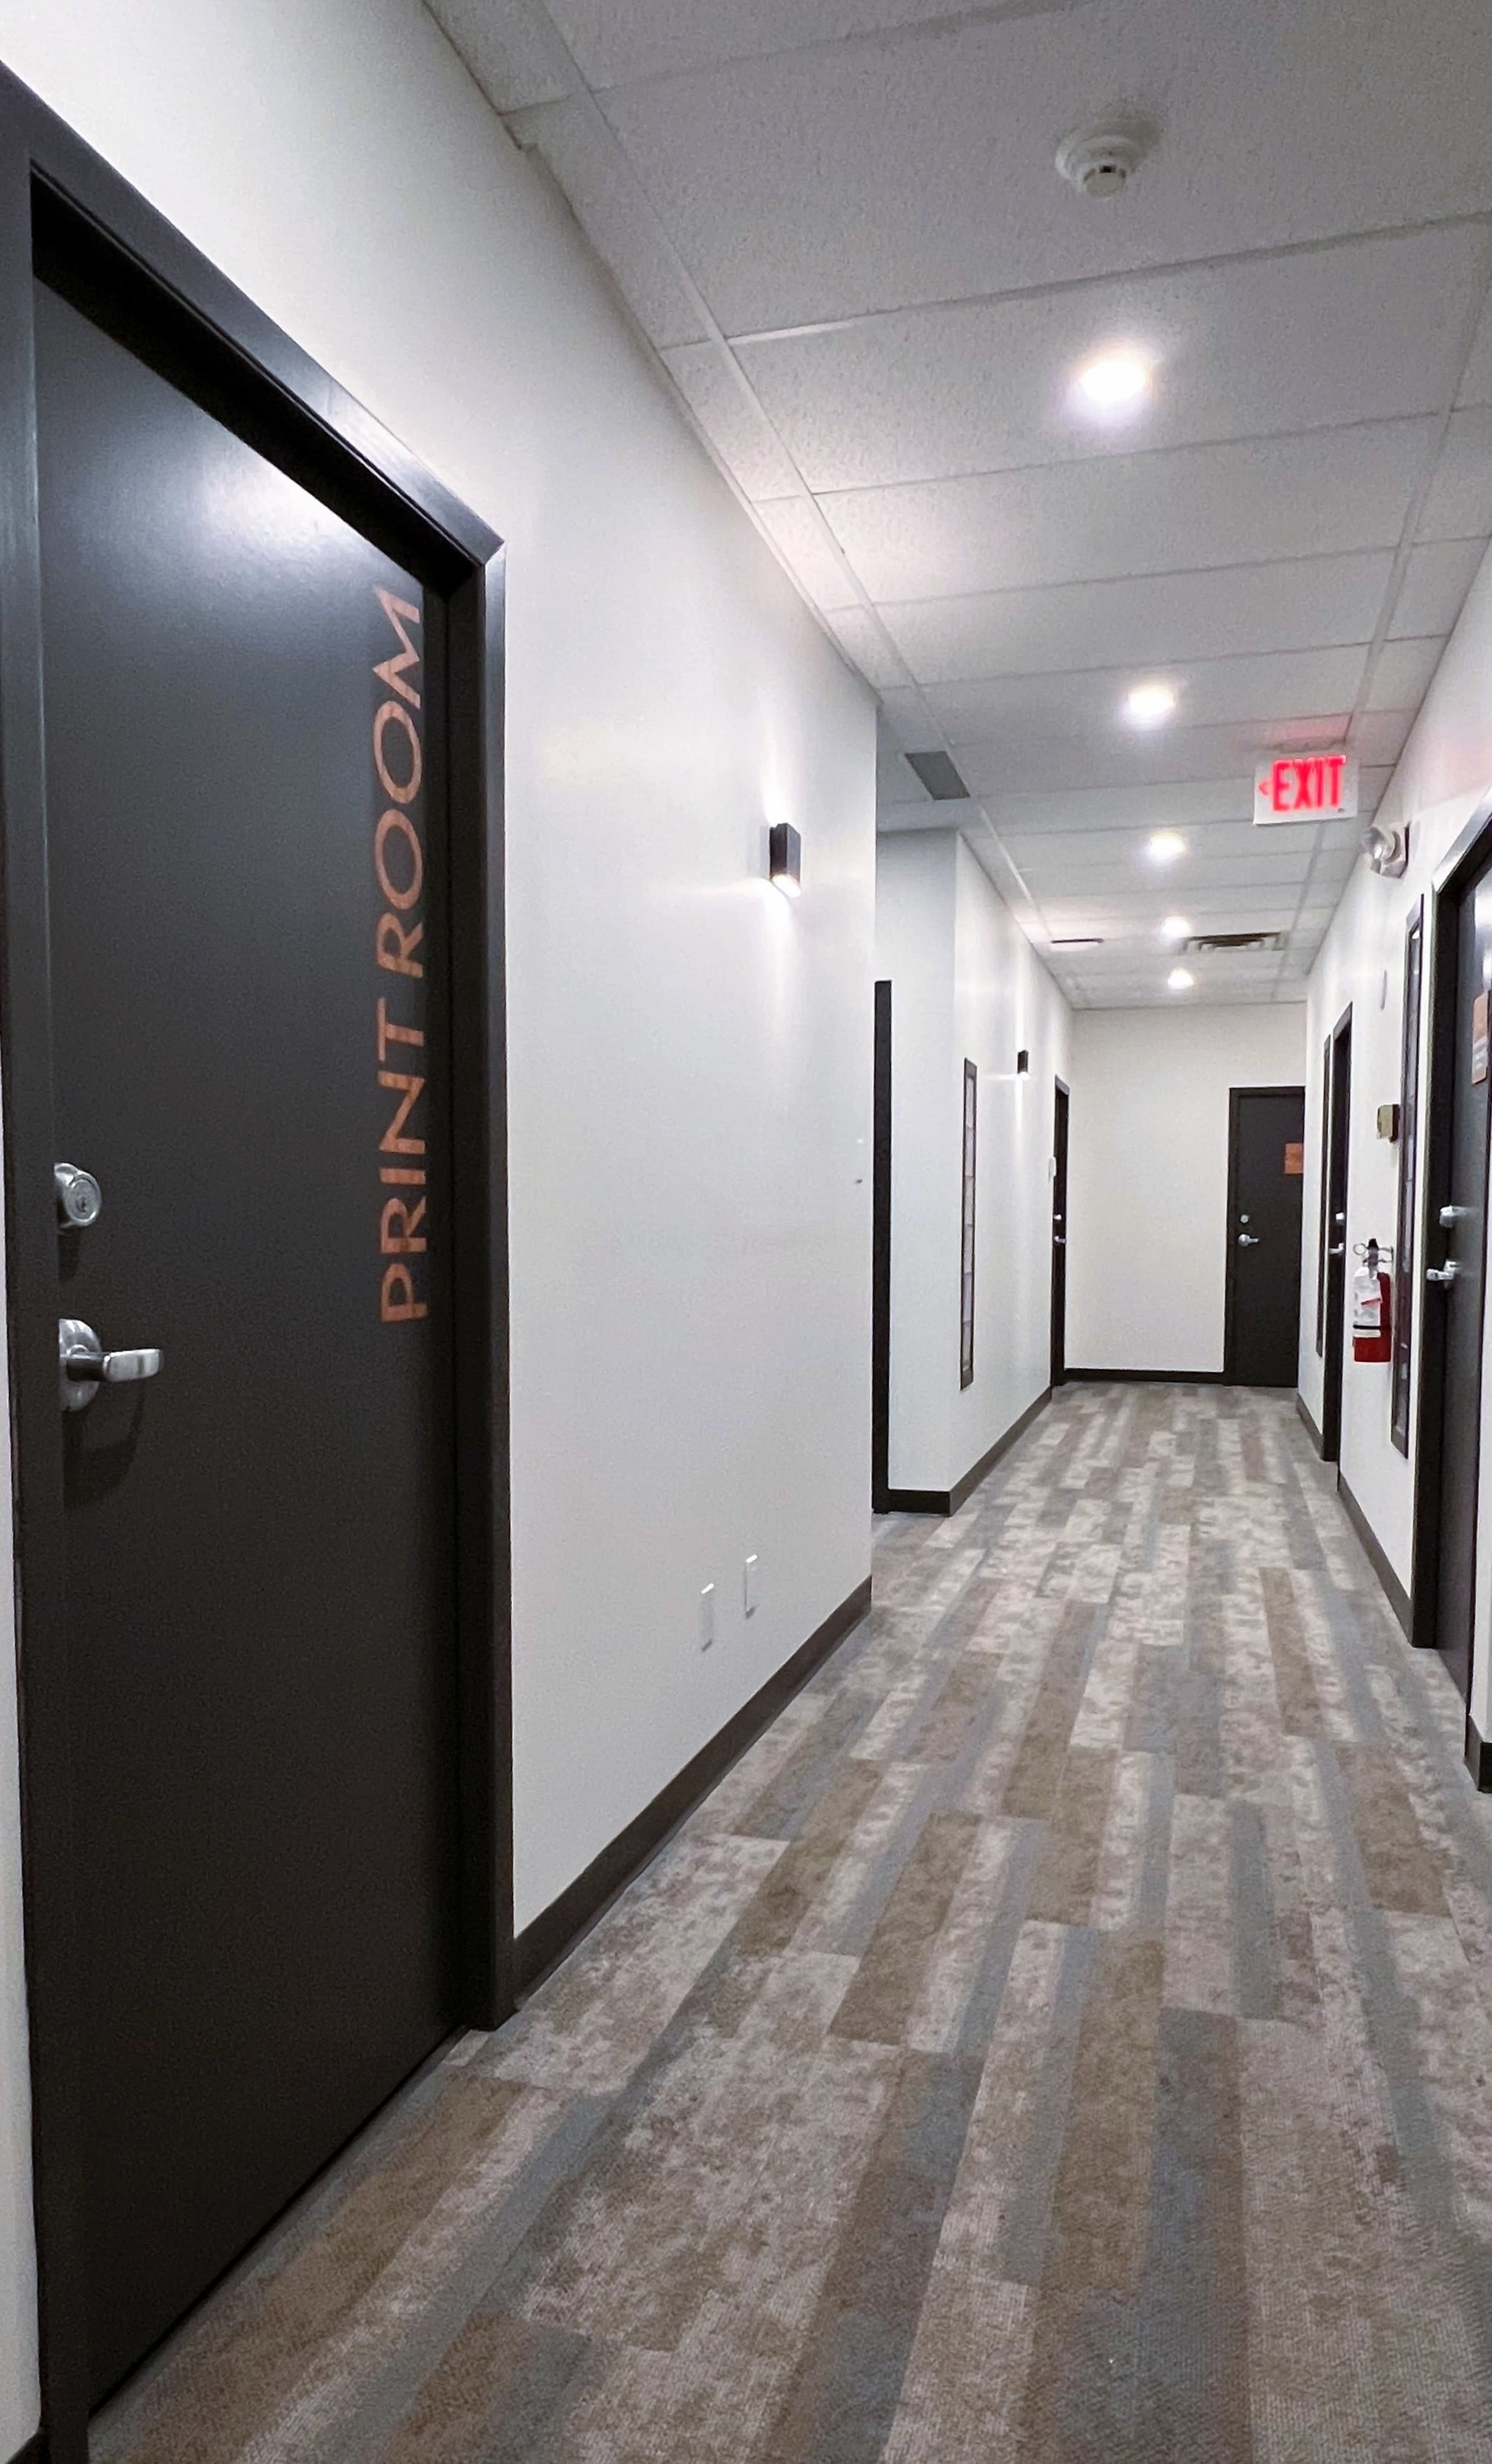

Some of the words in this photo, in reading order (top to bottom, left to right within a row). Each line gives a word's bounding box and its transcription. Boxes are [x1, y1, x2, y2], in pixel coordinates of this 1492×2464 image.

[372, 584, 424, 978] ROOM
[1272, 755, 1347, 811] EXIT
[377, 997, 427, 1322] PRINT
